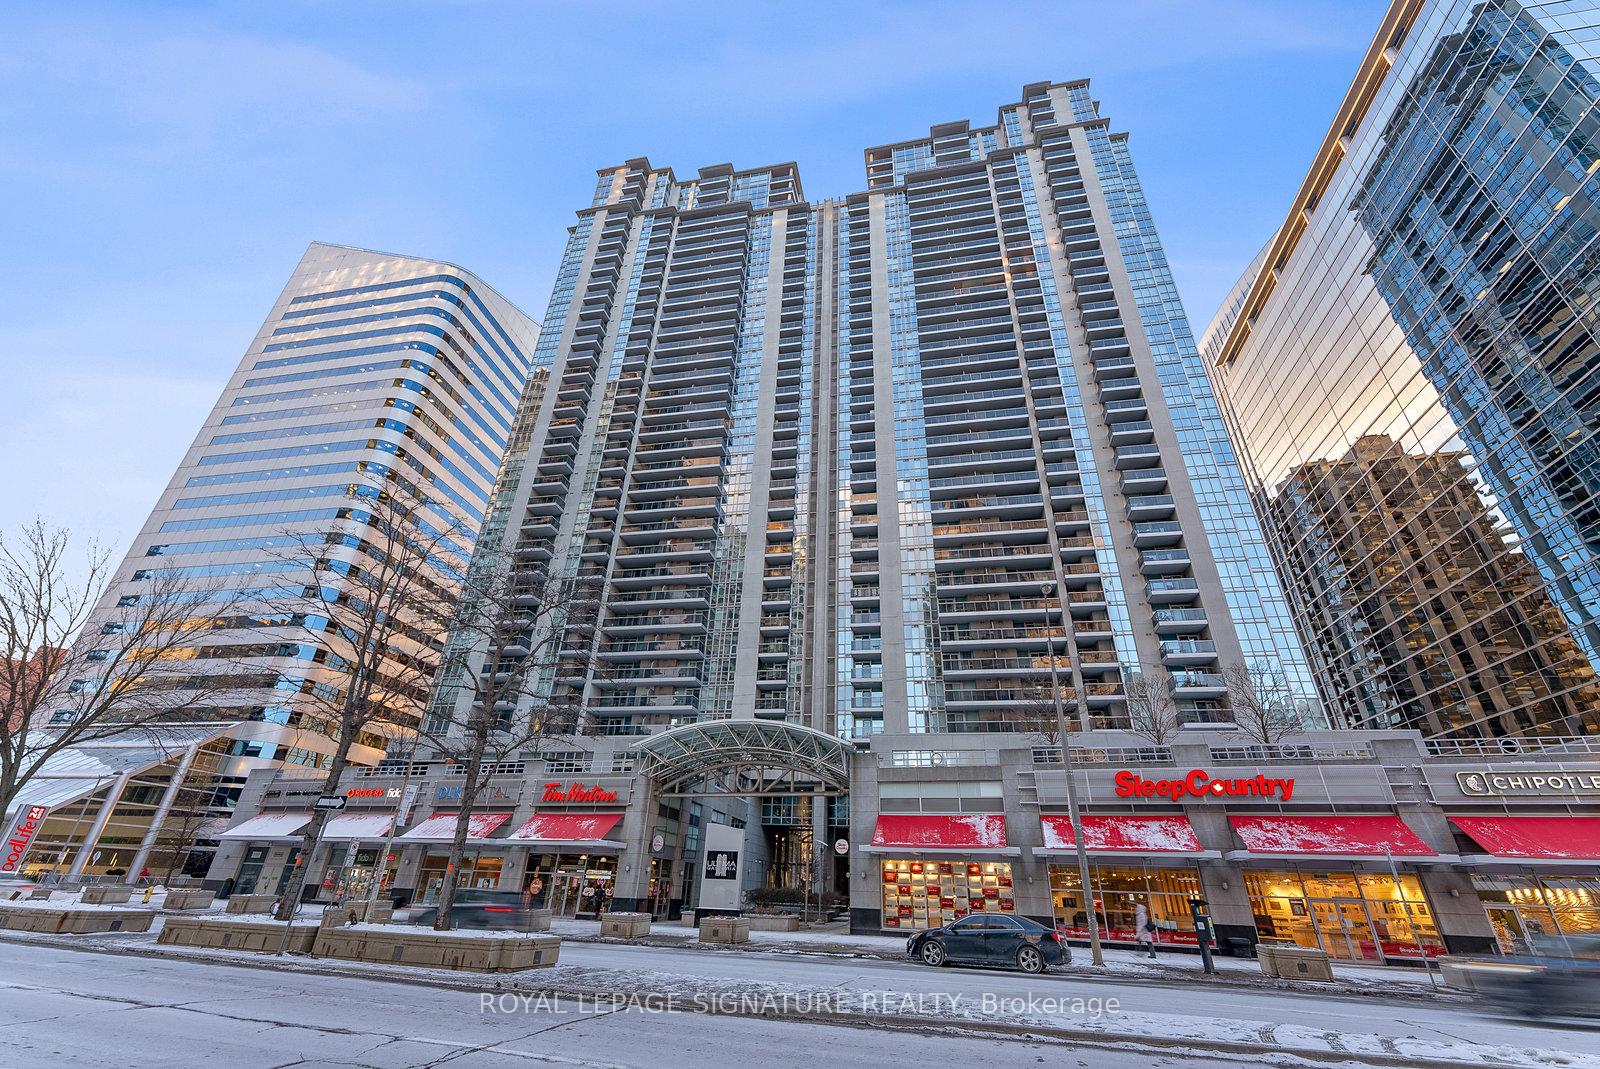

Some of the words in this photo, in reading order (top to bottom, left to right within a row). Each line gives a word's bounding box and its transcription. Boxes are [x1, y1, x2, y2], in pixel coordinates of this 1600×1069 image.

[354, 788, 385, 798] ROGERS
[541, 781, 567, 803] Tim
[565, 781, 618, 803] Hortons
[1114, 769, 1295, 801] SleepCountry
[1492, 775, 1600, 790] CHIPOTLE
[1, 821, 38, 872] oodLife
